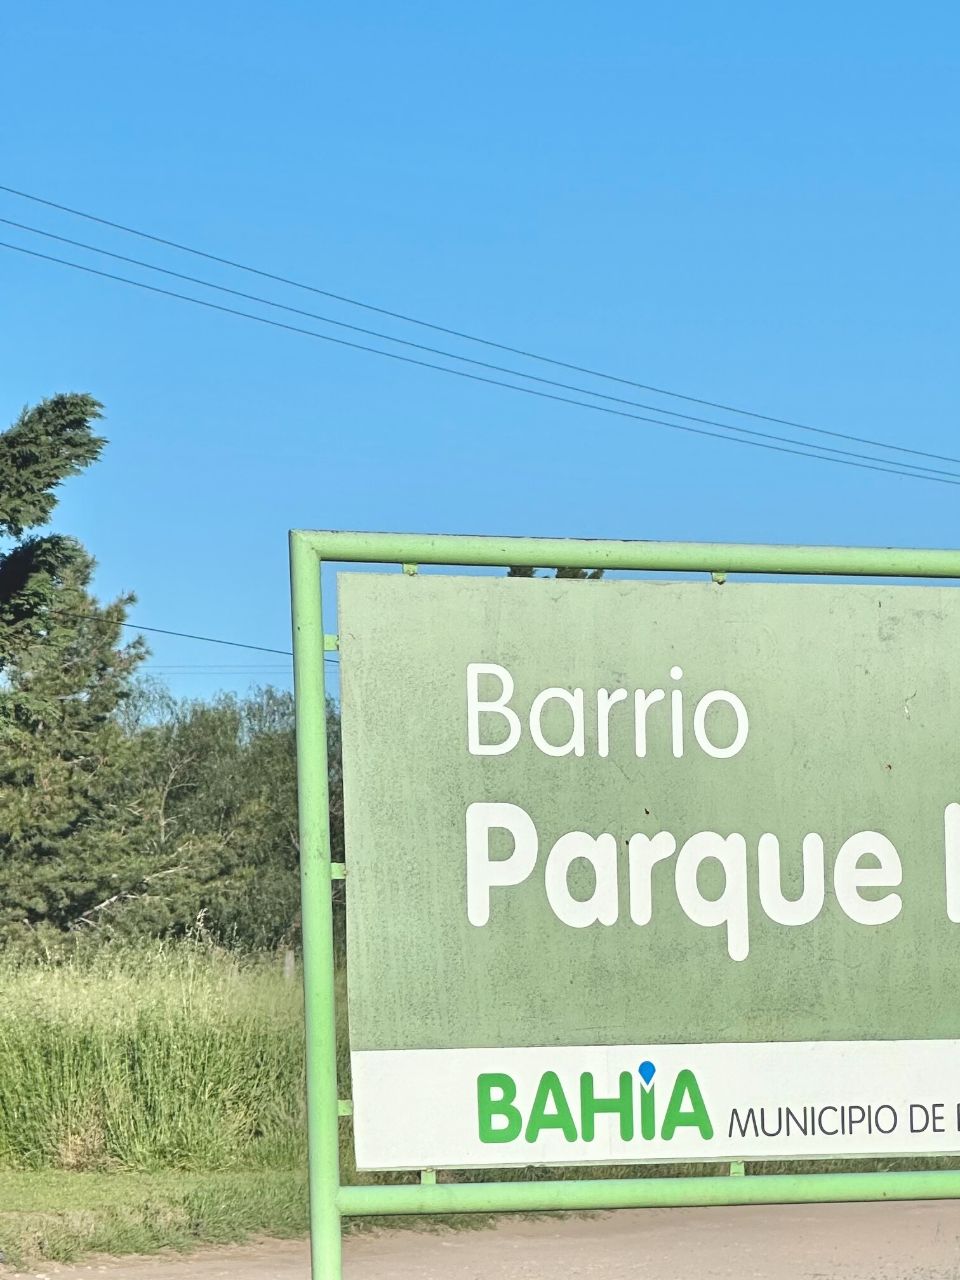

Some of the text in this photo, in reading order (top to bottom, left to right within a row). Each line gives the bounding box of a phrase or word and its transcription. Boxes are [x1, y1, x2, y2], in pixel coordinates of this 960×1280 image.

[465, 661, 750, 760] Barrio
[464, 801, 904, 963] Parque
[727, 1103, 899, 1139] MUNICIPIO
[908, 1103, 947, 1134] DE
